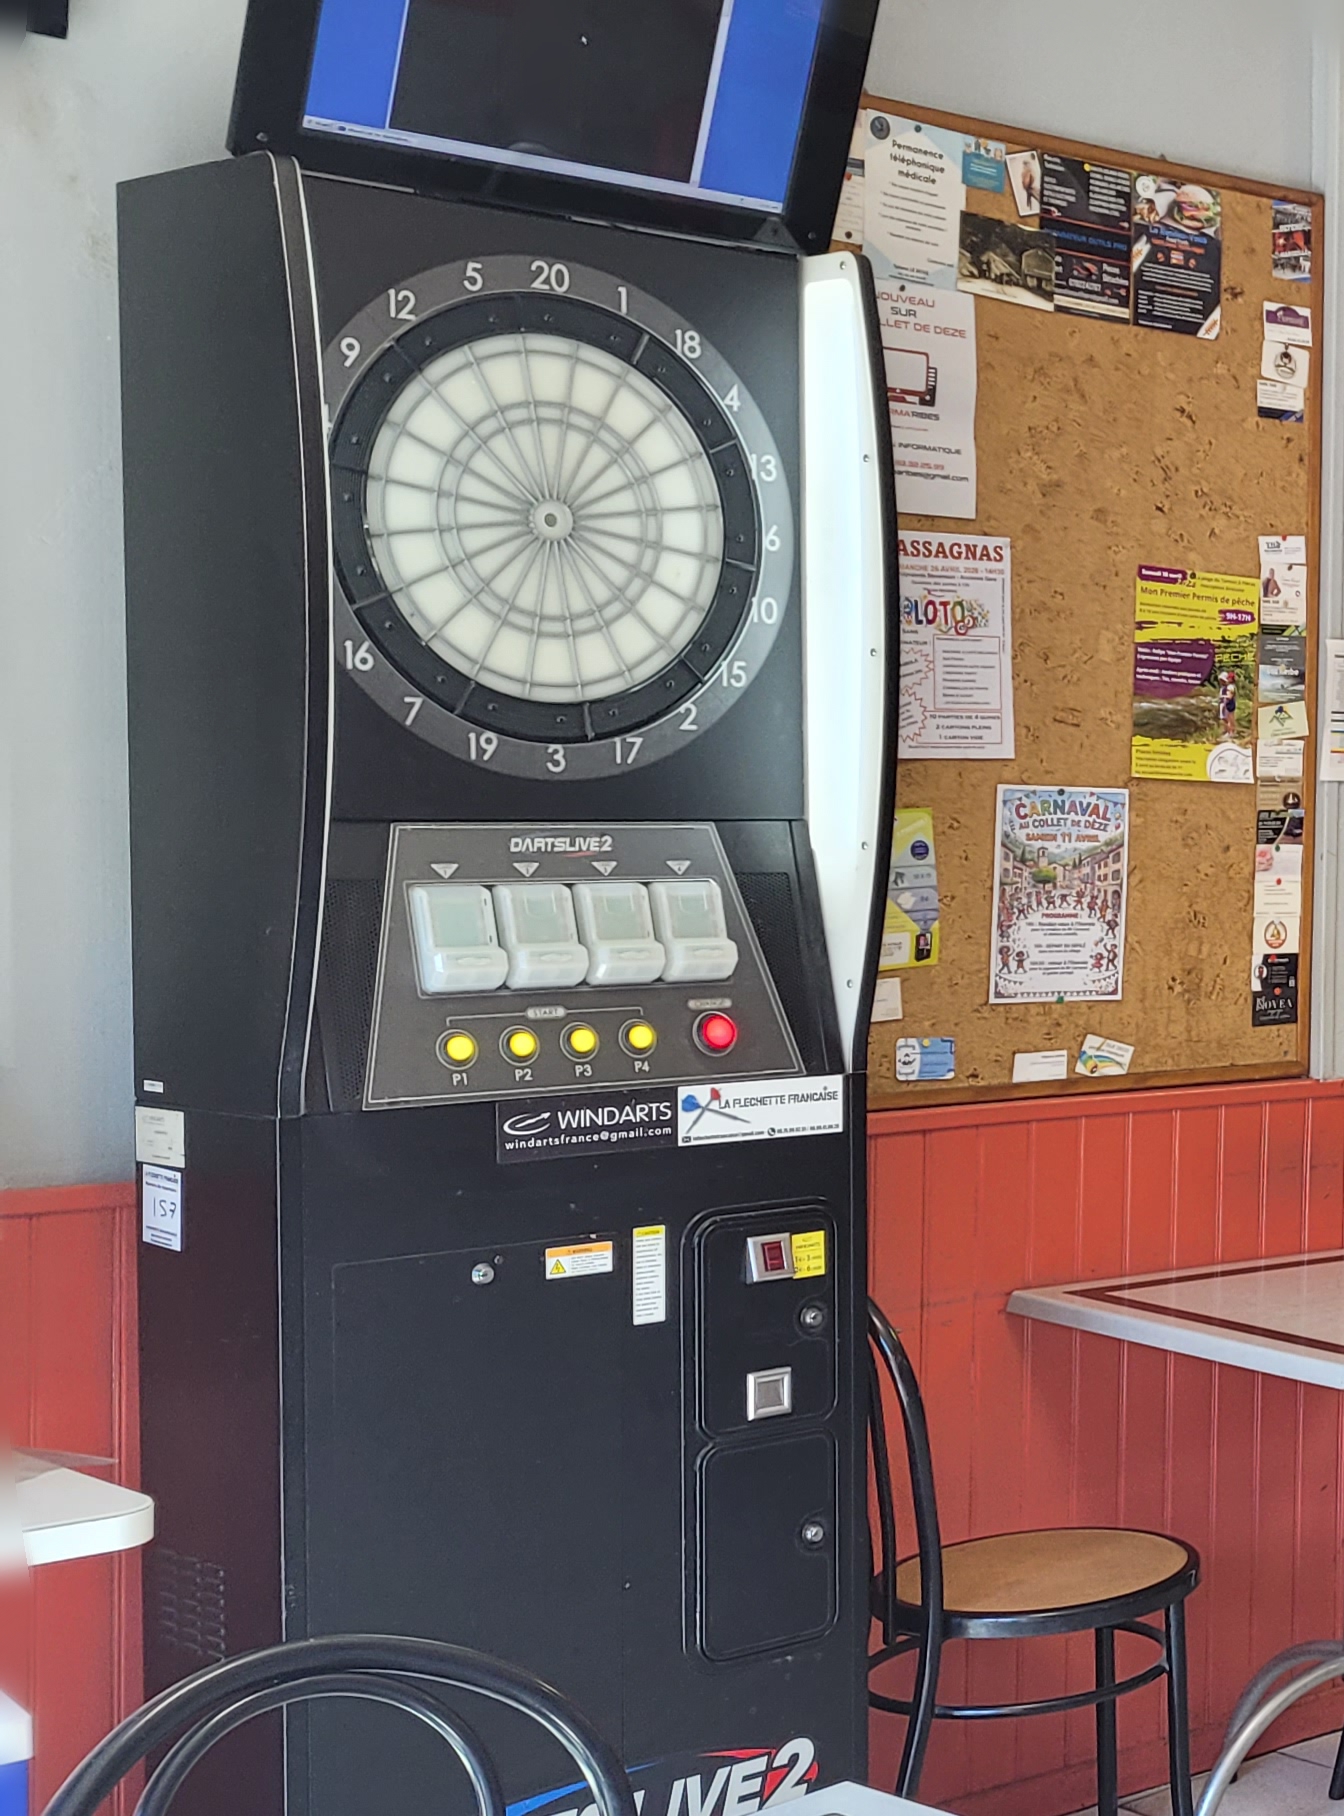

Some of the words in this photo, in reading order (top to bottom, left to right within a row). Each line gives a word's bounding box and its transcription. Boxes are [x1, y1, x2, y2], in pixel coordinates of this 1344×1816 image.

[892, 139, 944, 160] Permanence
[890, 153, 945, 174] téléphonique
[898, 169, 936, 185] médicale
[463, 262, 484, 290] 5
[530, 260, 570, 293] 20
[388, 289, 416, 322] 12
[617, 286, 629, 314] 1
[890, 306, 917, 318] SUR
[673, 328, 701, 358] 18
[914, 322, 930, 333] DE
[934, 325, 966, 338] DEZE
[339, 337, 361, 367] 9
[722, 384, 741, 411] 4
[898, 442, 962, 455] INFORMATIQUE
[750, 454, 778, 482] 13
[763, 525, 780, 552] 6
[751, 596, 779, 624] 10
[1140, 586, 1158, 596] Mon
[1160, 588, 1190, 599] Premier
[1192, 592, 1218, 603] Permis
[1220, 596, 1230, 604] de
[1231, 597, 1256, 607] pêche
[913, 598, 965, 626] LOTO
[343, 640, 374, 671] 16
[720, 661, 747, 687] 15
[402, 697, 424, 726] 7
[679, 703, 698, 730] 2
[467, 732, 499, 761] 19
[546, 744, 566, 772] 3
[615, 736, 643, 764] 17
[1015, 799, 1111, 822] CARNAVAL
[1019, 821, 1030, 830] AU
[1032, 818, 1069, 828] COLLET
[509, 835, 613, 853] DARTSLIVE2
[532, 1008, 560, 1017] START
[452, 1073, 468, 1087] P1
[514, 1068, 533, 1082] P2
[575, 1064, 593, 1078] P3
[634, 1060, 650, 1074] P4
[719, 1097, 731, 1109] LA
[732, 1094, 786, 1109] FLECHETTE
[557, 1102, 672, 1129] WINDARTS
[504, 1126, 672, 1150] windartsfrance@gmail.com
